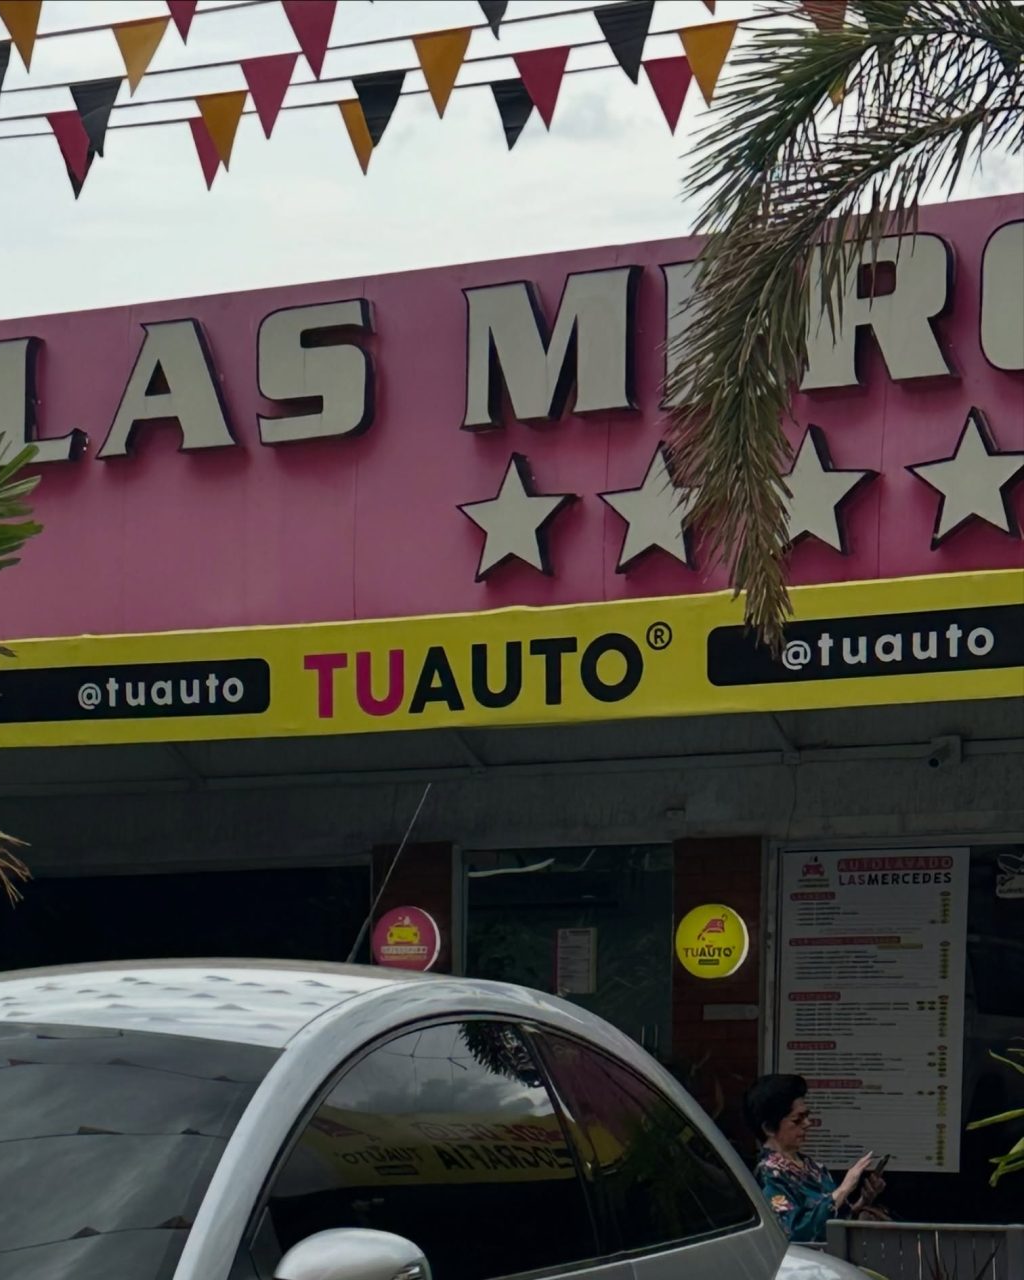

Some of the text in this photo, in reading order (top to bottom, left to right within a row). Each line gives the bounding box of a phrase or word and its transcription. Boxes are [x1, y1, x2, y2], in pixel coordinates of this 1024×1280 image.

[781, 622, 995, 670] @tuauto
[78, 673, 245, 710] @tuauto
[838, 857, 953, 871] AUTOLAVADO
[838, 872, 953, 886] LASMERCEDES
